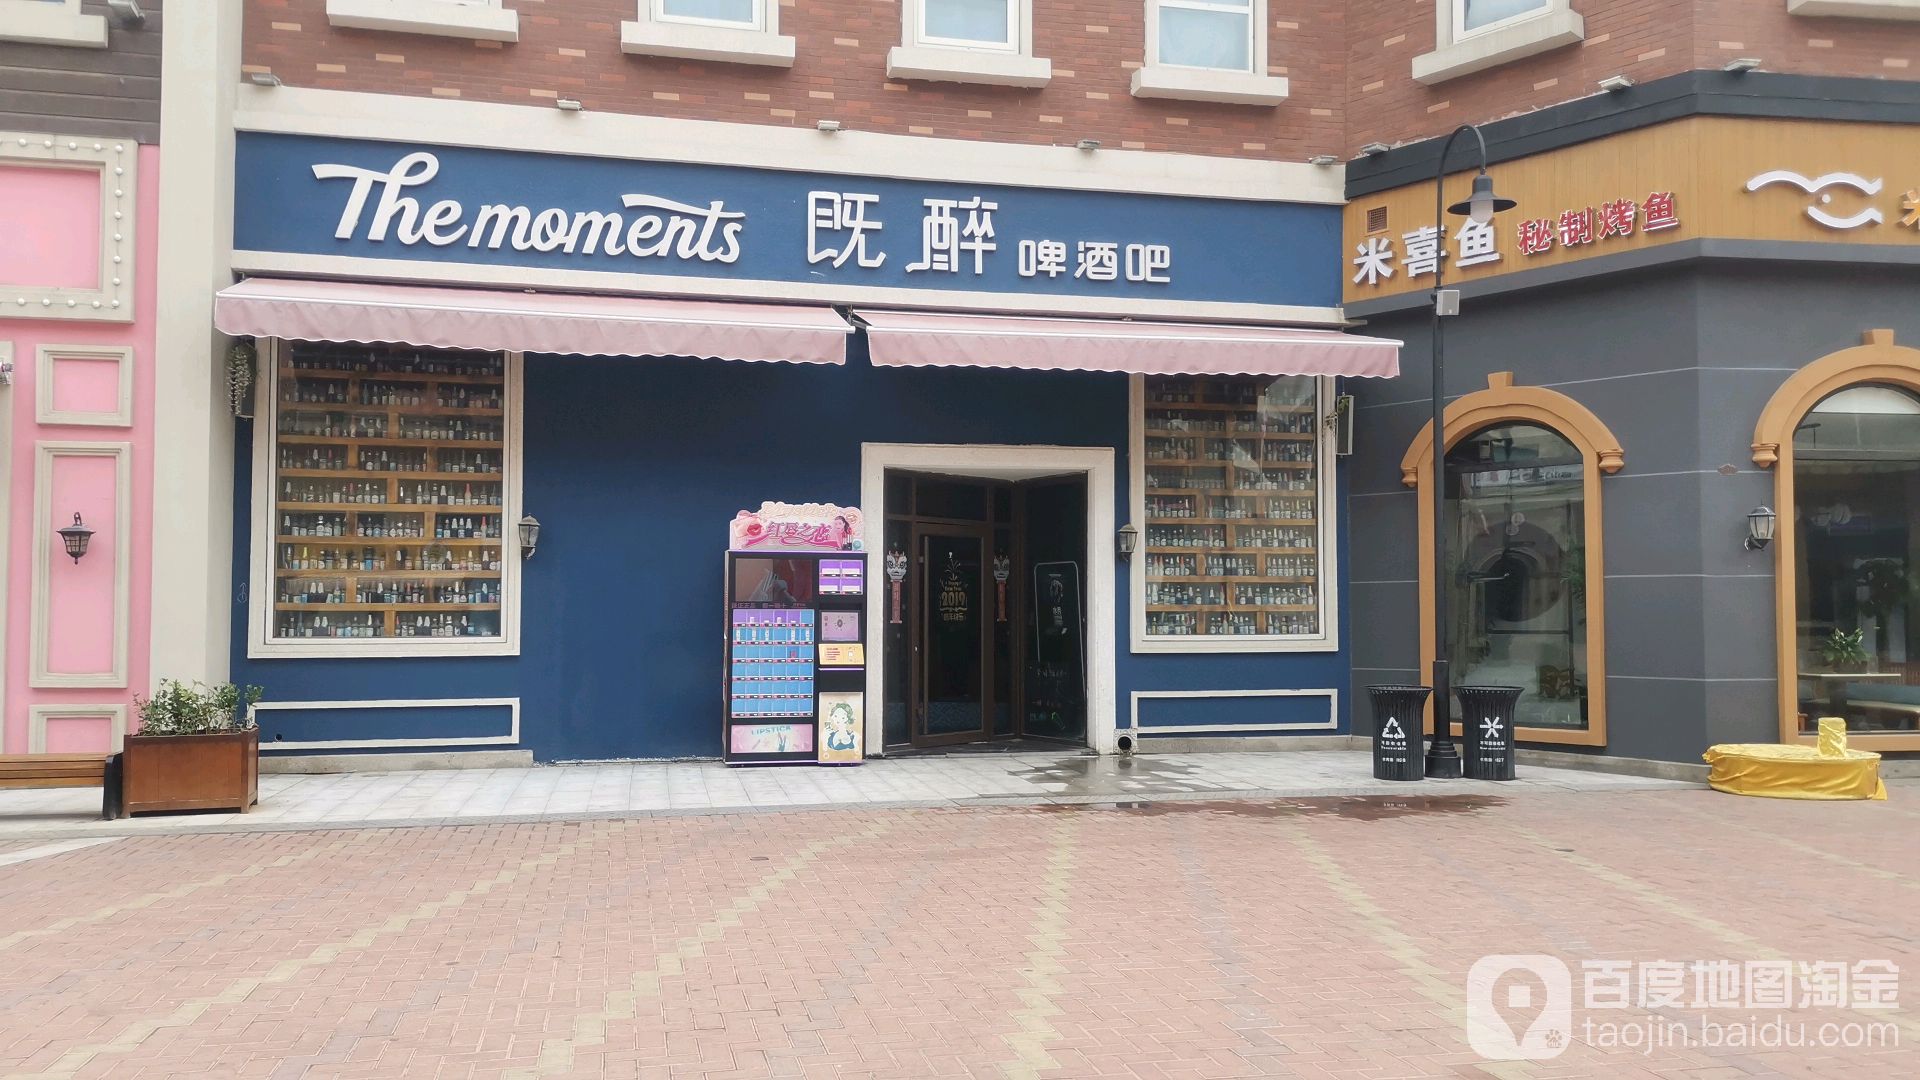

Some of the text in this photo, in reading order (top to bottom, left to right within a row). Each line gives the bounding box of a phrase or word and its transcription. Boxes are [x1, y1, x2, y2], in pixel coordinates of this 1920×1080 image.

[312, 152, 745, 263] The moments
[1352, 191, 1679, 285] 米喜鱼 秘制烤鱼
[1018, 239, 1171, 283] 啤酒吧
[942, 591, 966, 606] 2019
[751, 725, 791, 736] LIPSTICK
